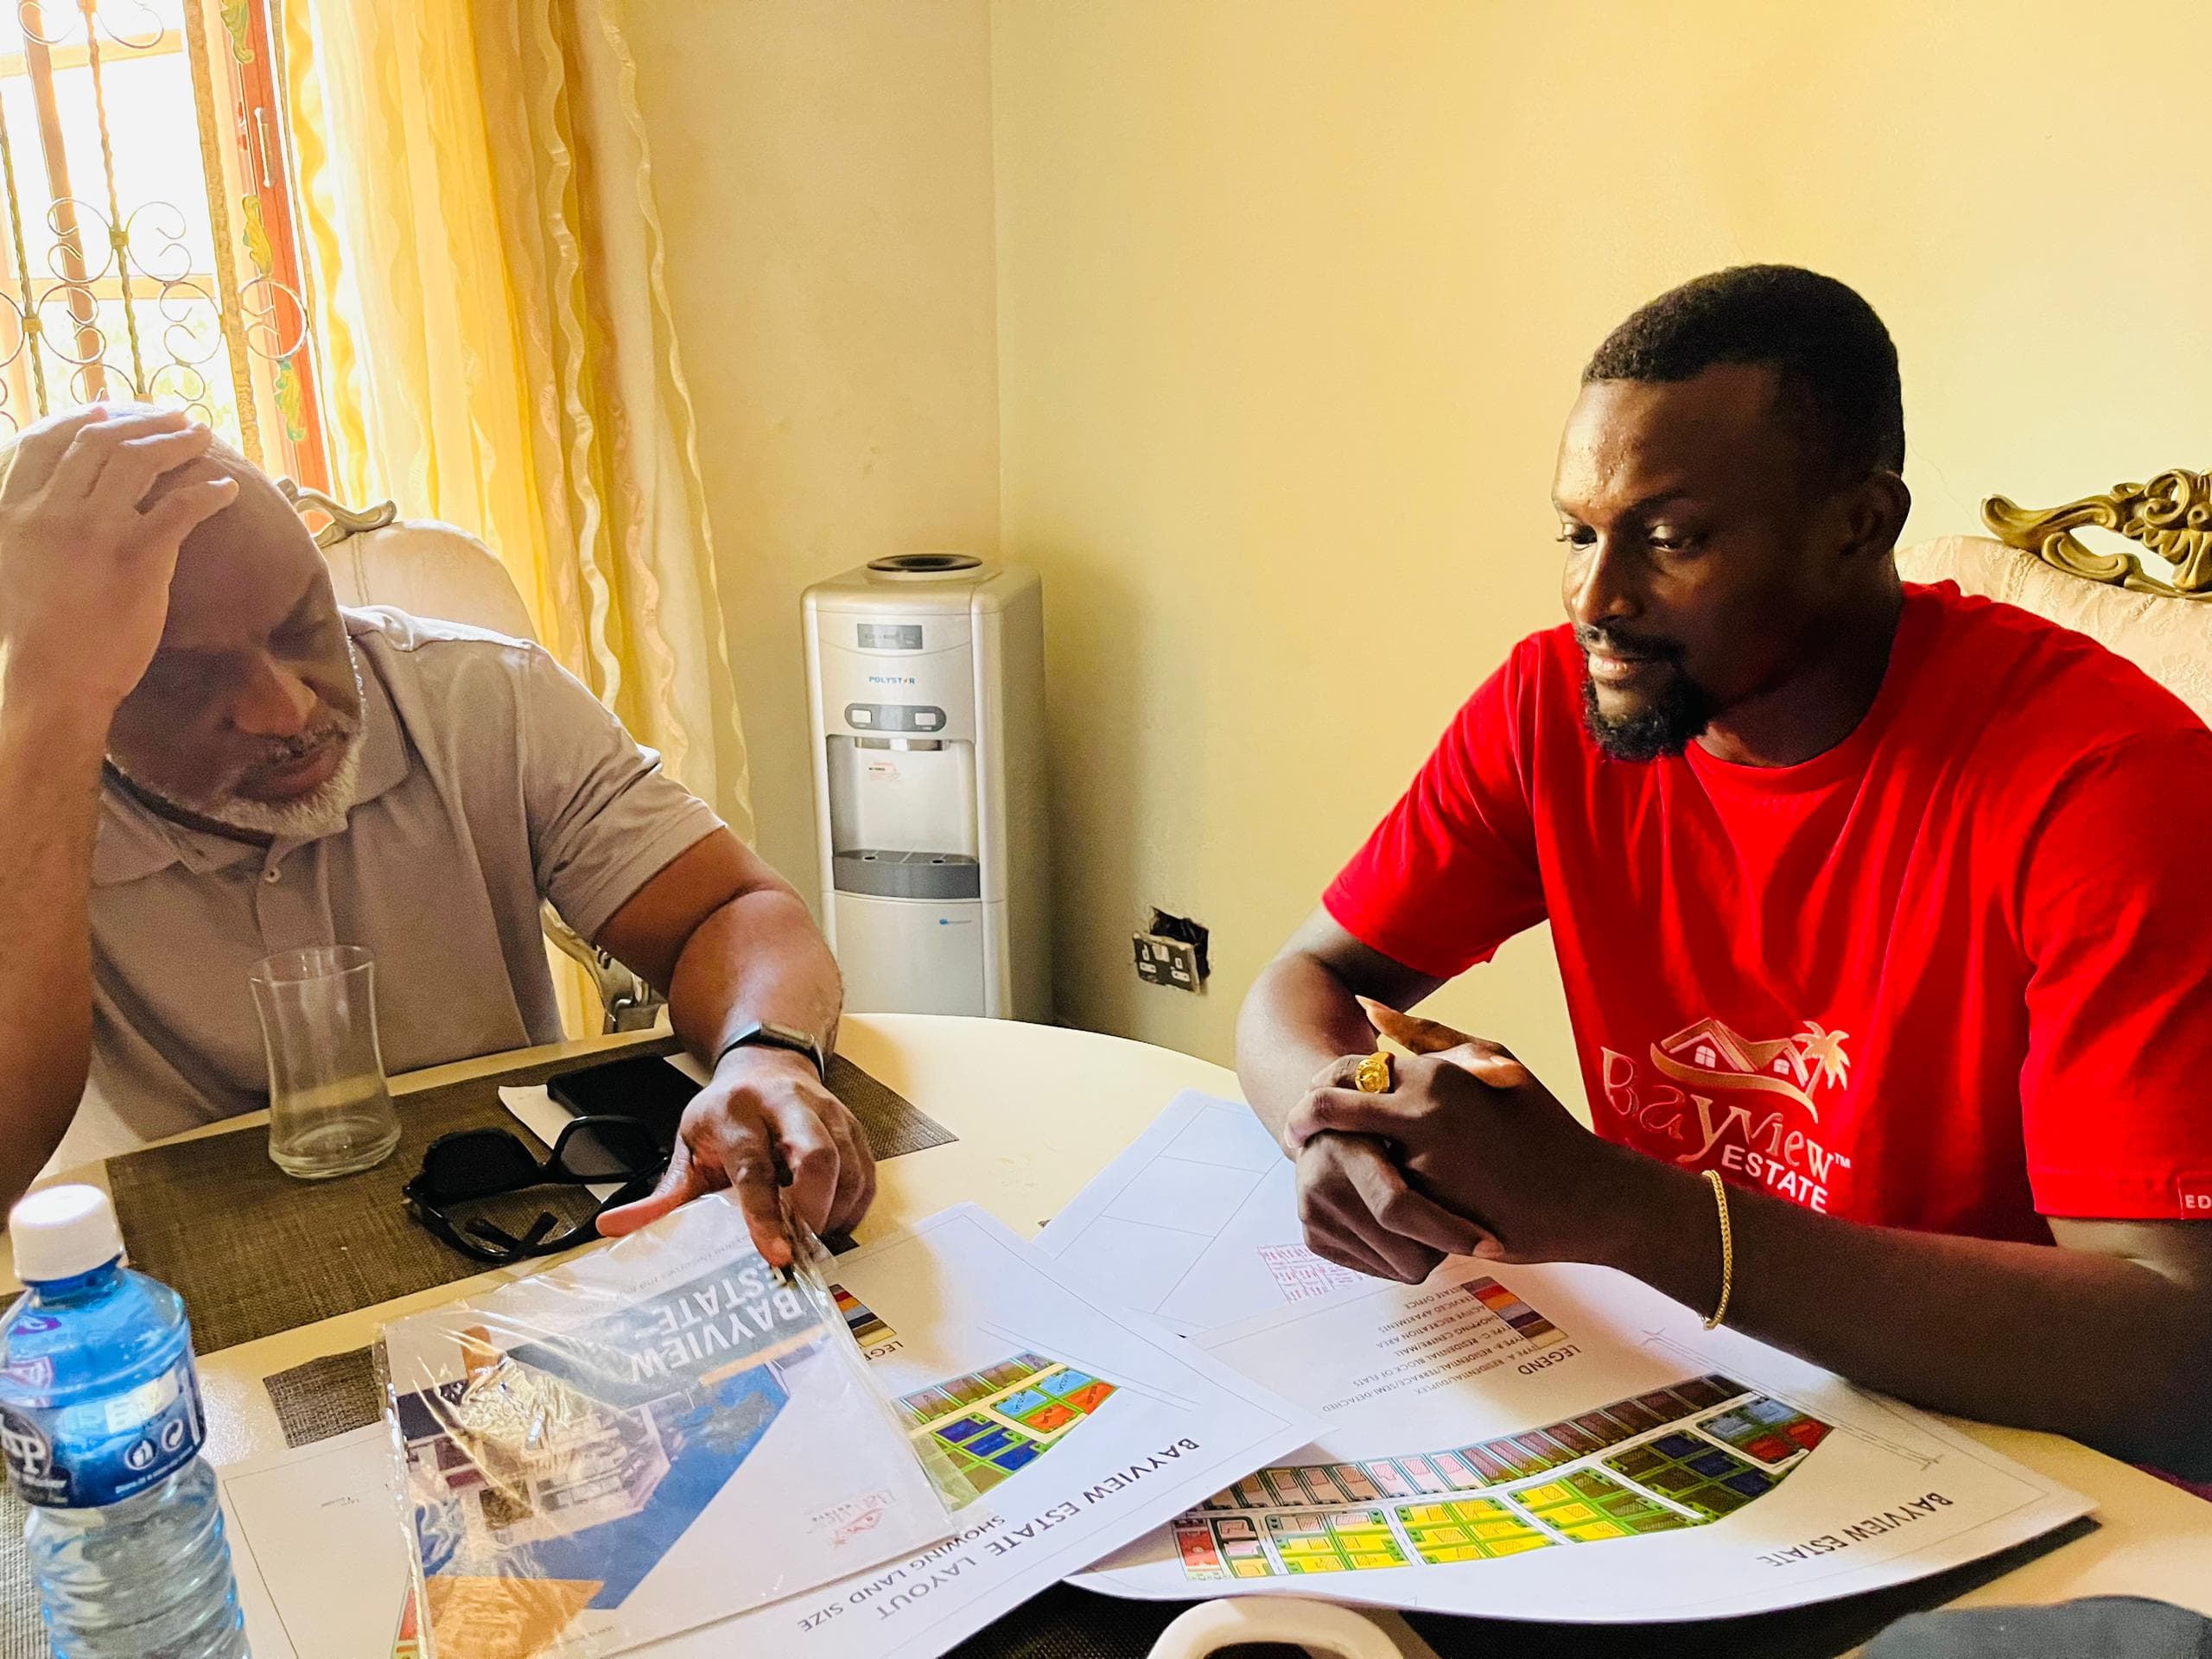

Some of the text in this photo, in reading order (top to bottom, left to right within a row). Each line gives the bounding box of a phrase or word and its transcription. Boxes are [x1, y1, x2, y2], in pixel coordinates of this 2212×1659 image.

[1721, 1144, 1828, 1214] ESTATE
[629, 1285, 804, 1382] BAYVIEW
[1426, 1337, 1479, 1361] RESIDENTIAL
[1517, 1344, 1582, 1376] LEGEND
[876, 1437, 1200, 1621] BAYVIEW ESTATE LAYOUT
[1756, 1491, 1955, 1567] BAYVIEW ESTATE
[797, 1514, 1006, 1632] SHOWING LAND SIZE
